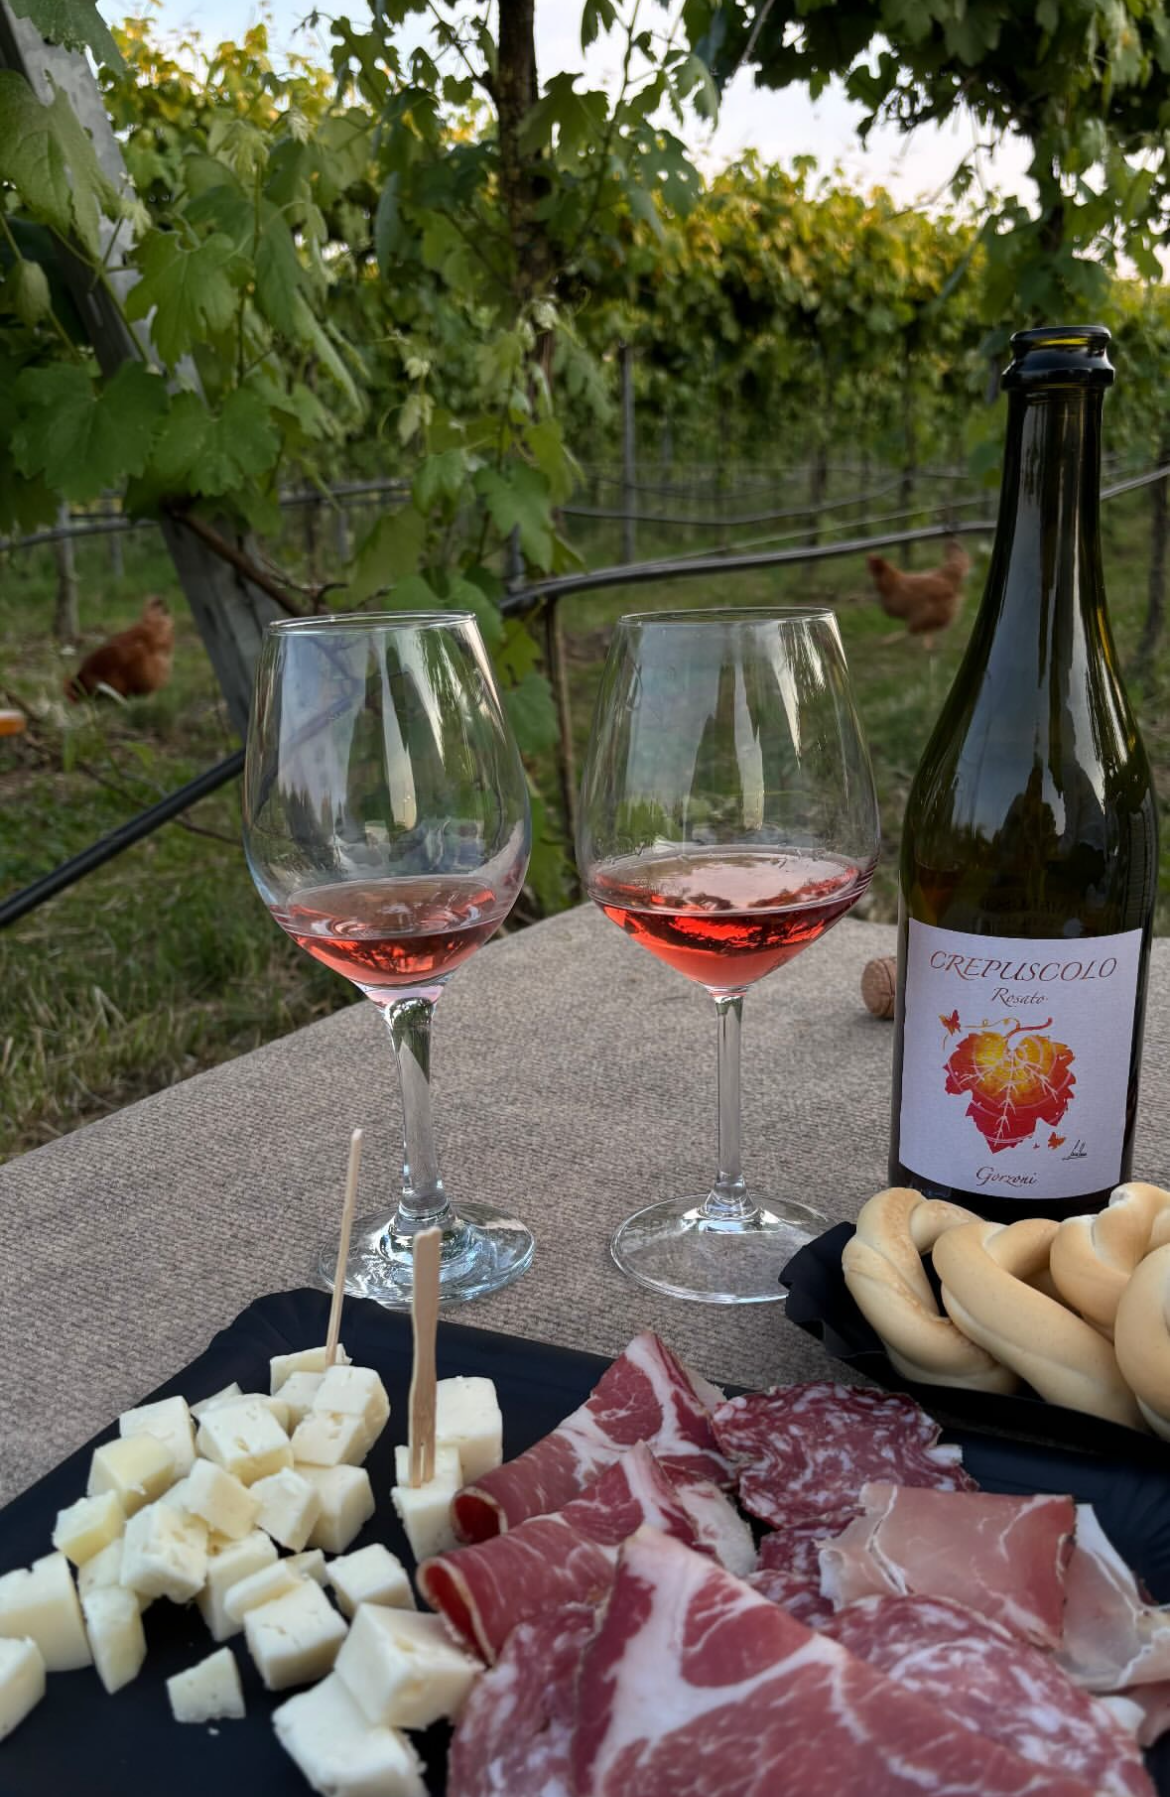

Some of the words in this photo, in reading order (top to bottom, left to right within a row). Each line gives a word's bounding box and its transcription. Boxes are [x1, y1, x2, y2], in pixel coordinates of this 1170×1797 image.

[929, 950, 1117, 982] CREPUSCOLO
[990, 987, 1047, 1007] Rosato
[975, 1166, 1038, 1187] Gorzoni
